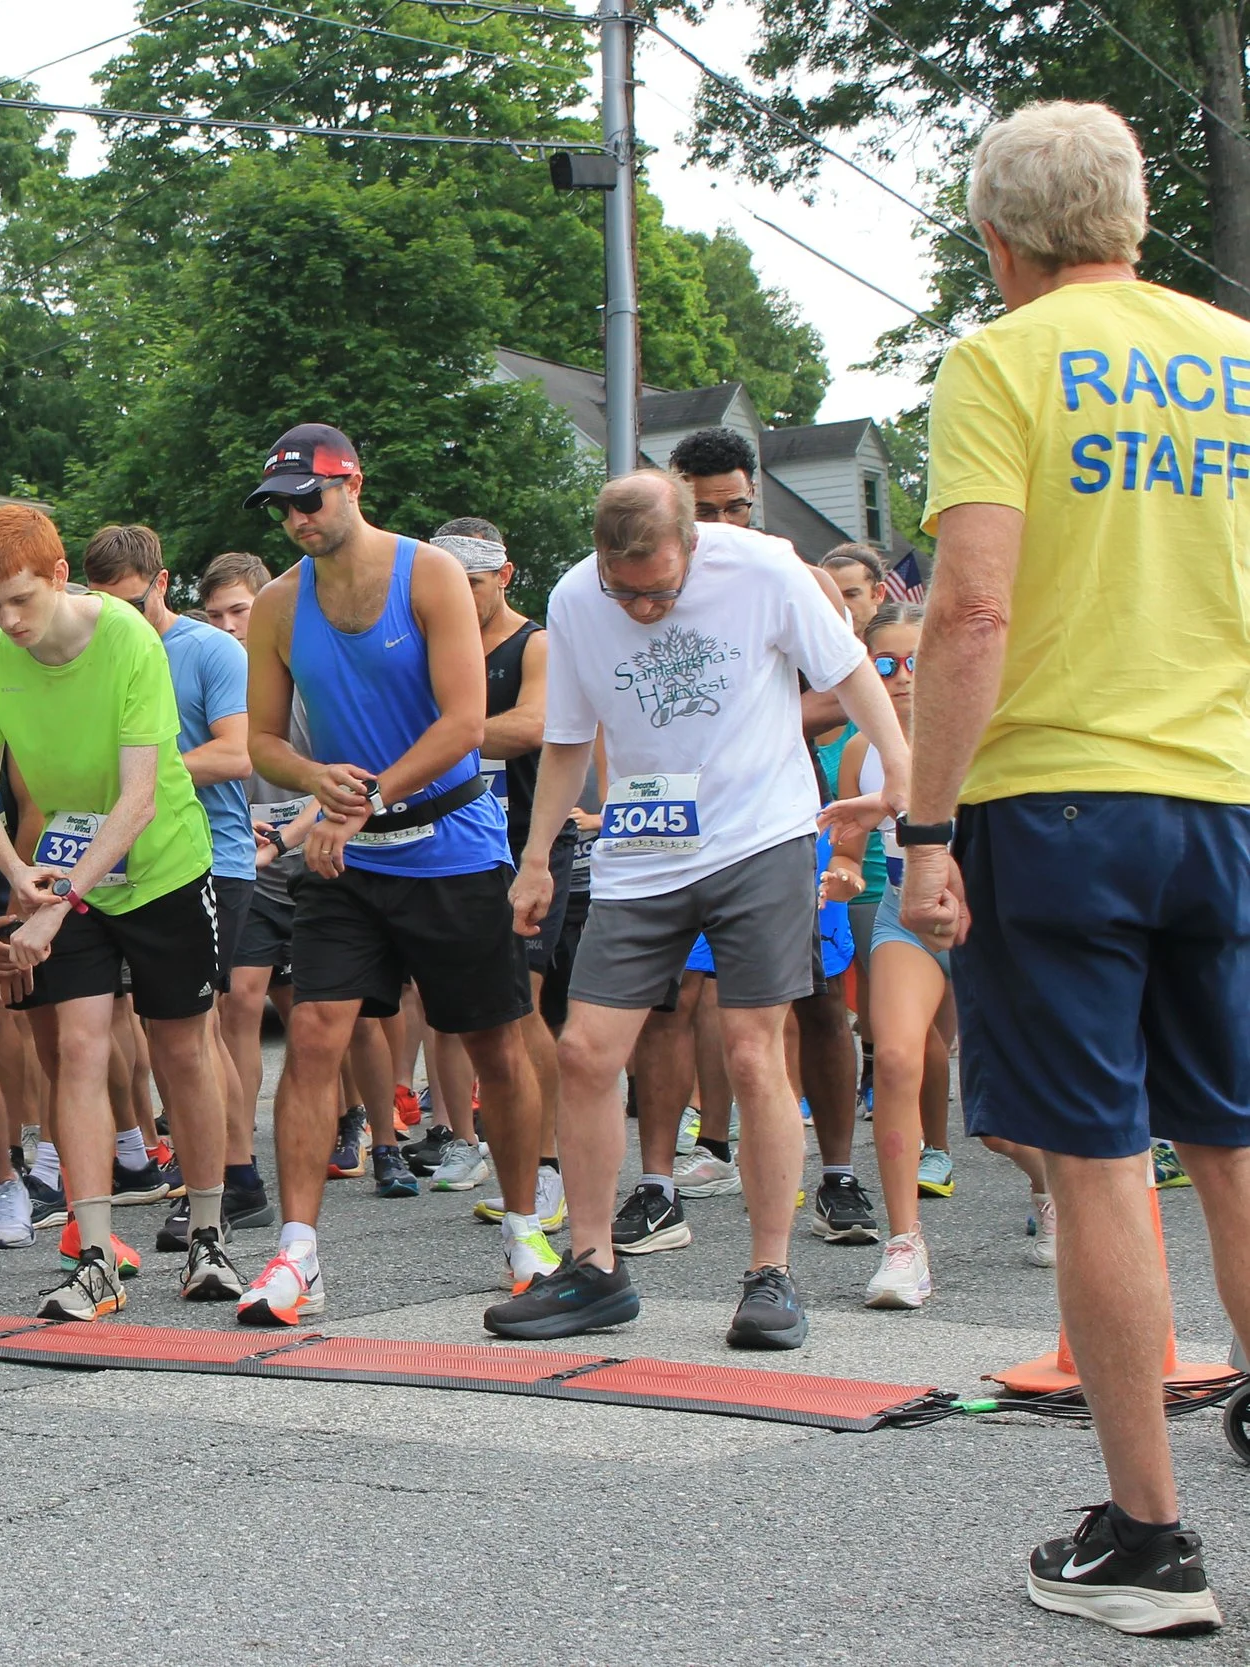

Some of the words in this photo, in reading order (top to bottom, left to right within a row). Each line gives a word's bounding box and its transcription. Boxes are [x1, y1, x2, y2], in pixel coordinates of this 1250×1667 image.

[1059, 347, 1250, 416] RACE
[1069, 431, 1250, 500] STAFF
[614, 641, 741, 690] Samantha's
[636, 674, 730, 713] Harvest
[629, 780, 657, 790] Second
[640, 788, 660, 798] Wind
[269, 804, 296, 814] Second
[66, 816, 90, 826] Second
[73, 823, 91, 834] Wind
[608, 805, 688, 835] 3045
